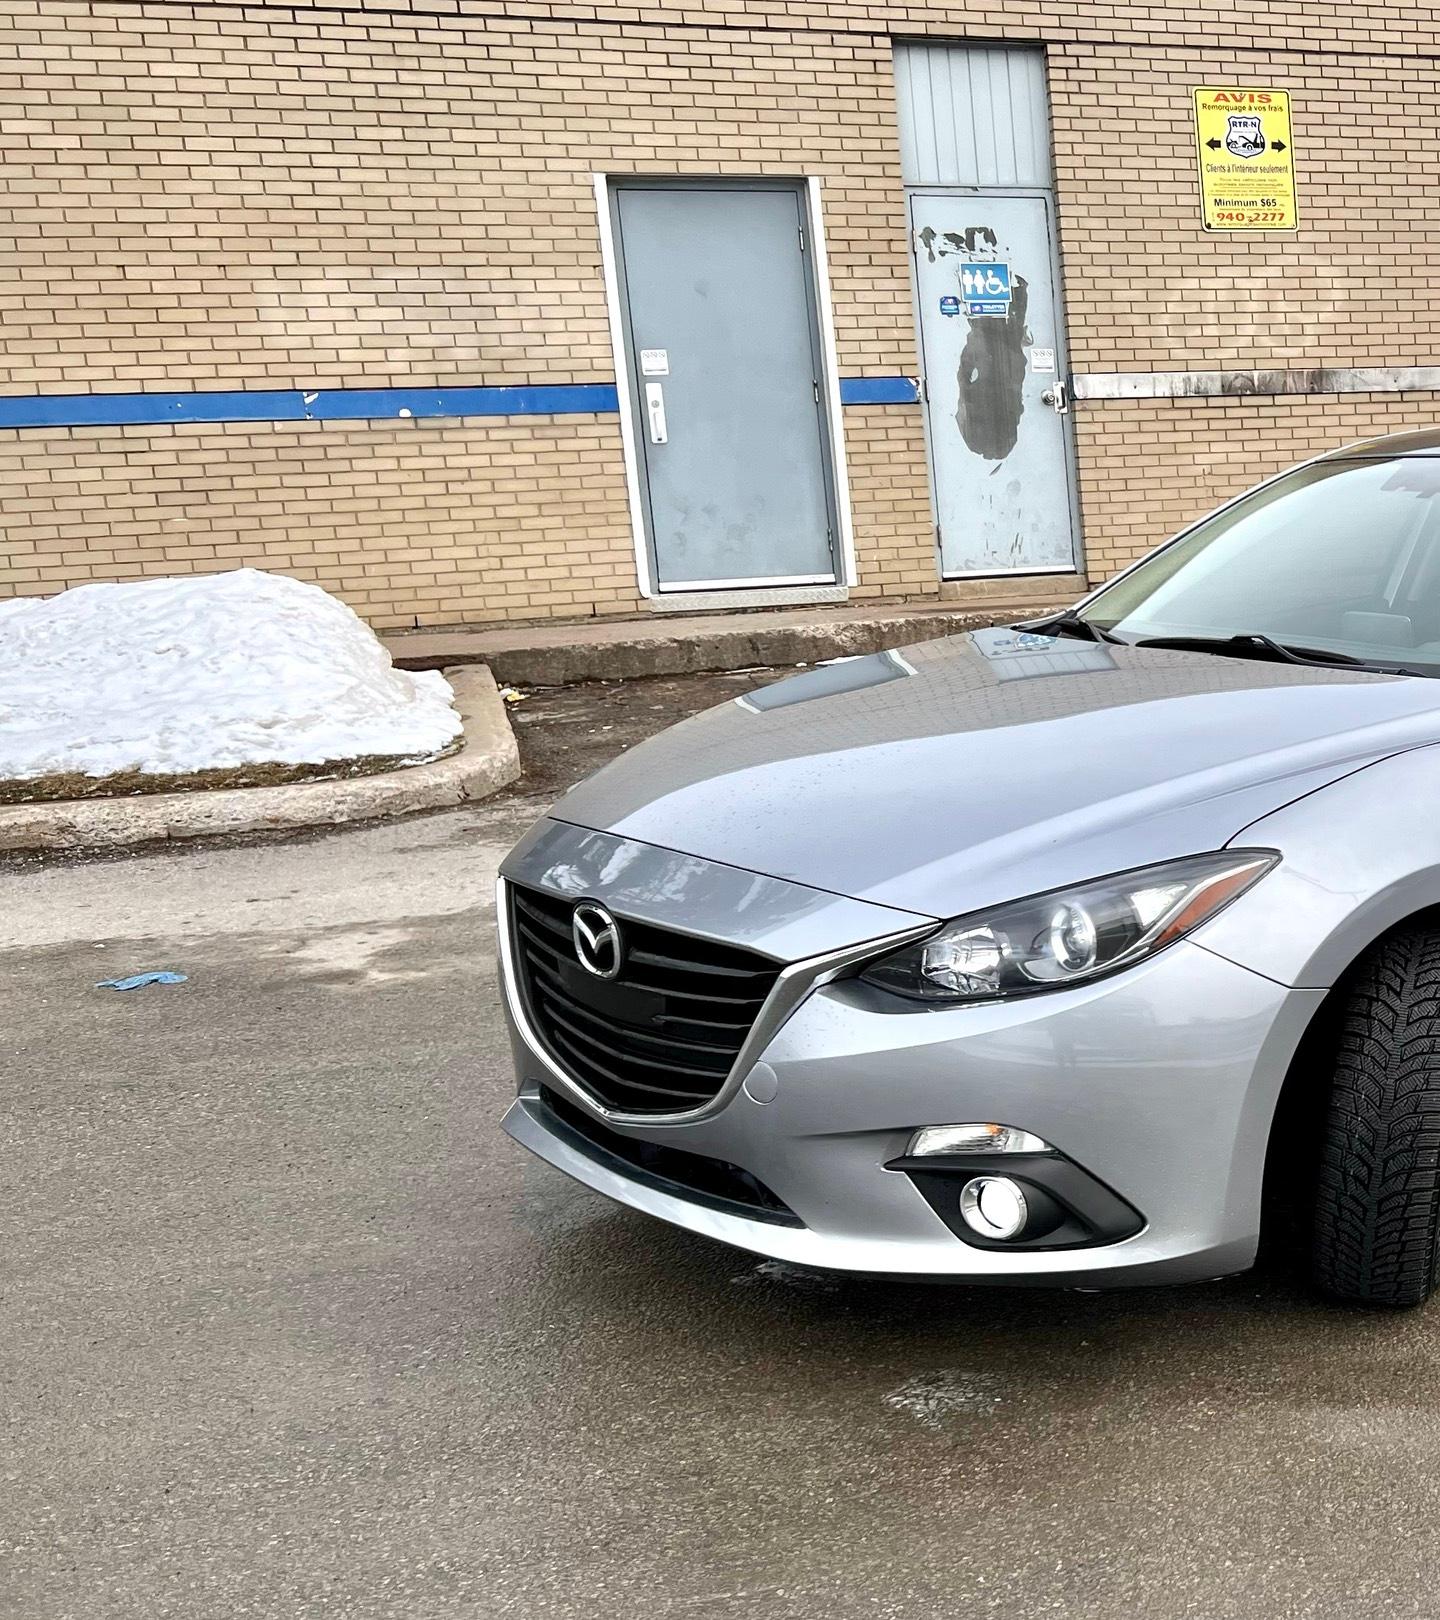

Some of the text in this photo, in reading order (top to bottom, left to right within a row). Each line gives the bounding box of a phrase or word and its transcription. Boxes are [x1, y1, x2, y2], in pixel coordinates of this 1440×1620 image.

[1213, 92, 1272, 104] AVIS
[1202, 103, 1246, 113] Remorquage
[1206, 163, 1226, 173] Clients
[1260, 164, 1289, 174] seulement
[1214, 198, 1258, 207] Minimum
[1260, 199, 1277, 207] $65
